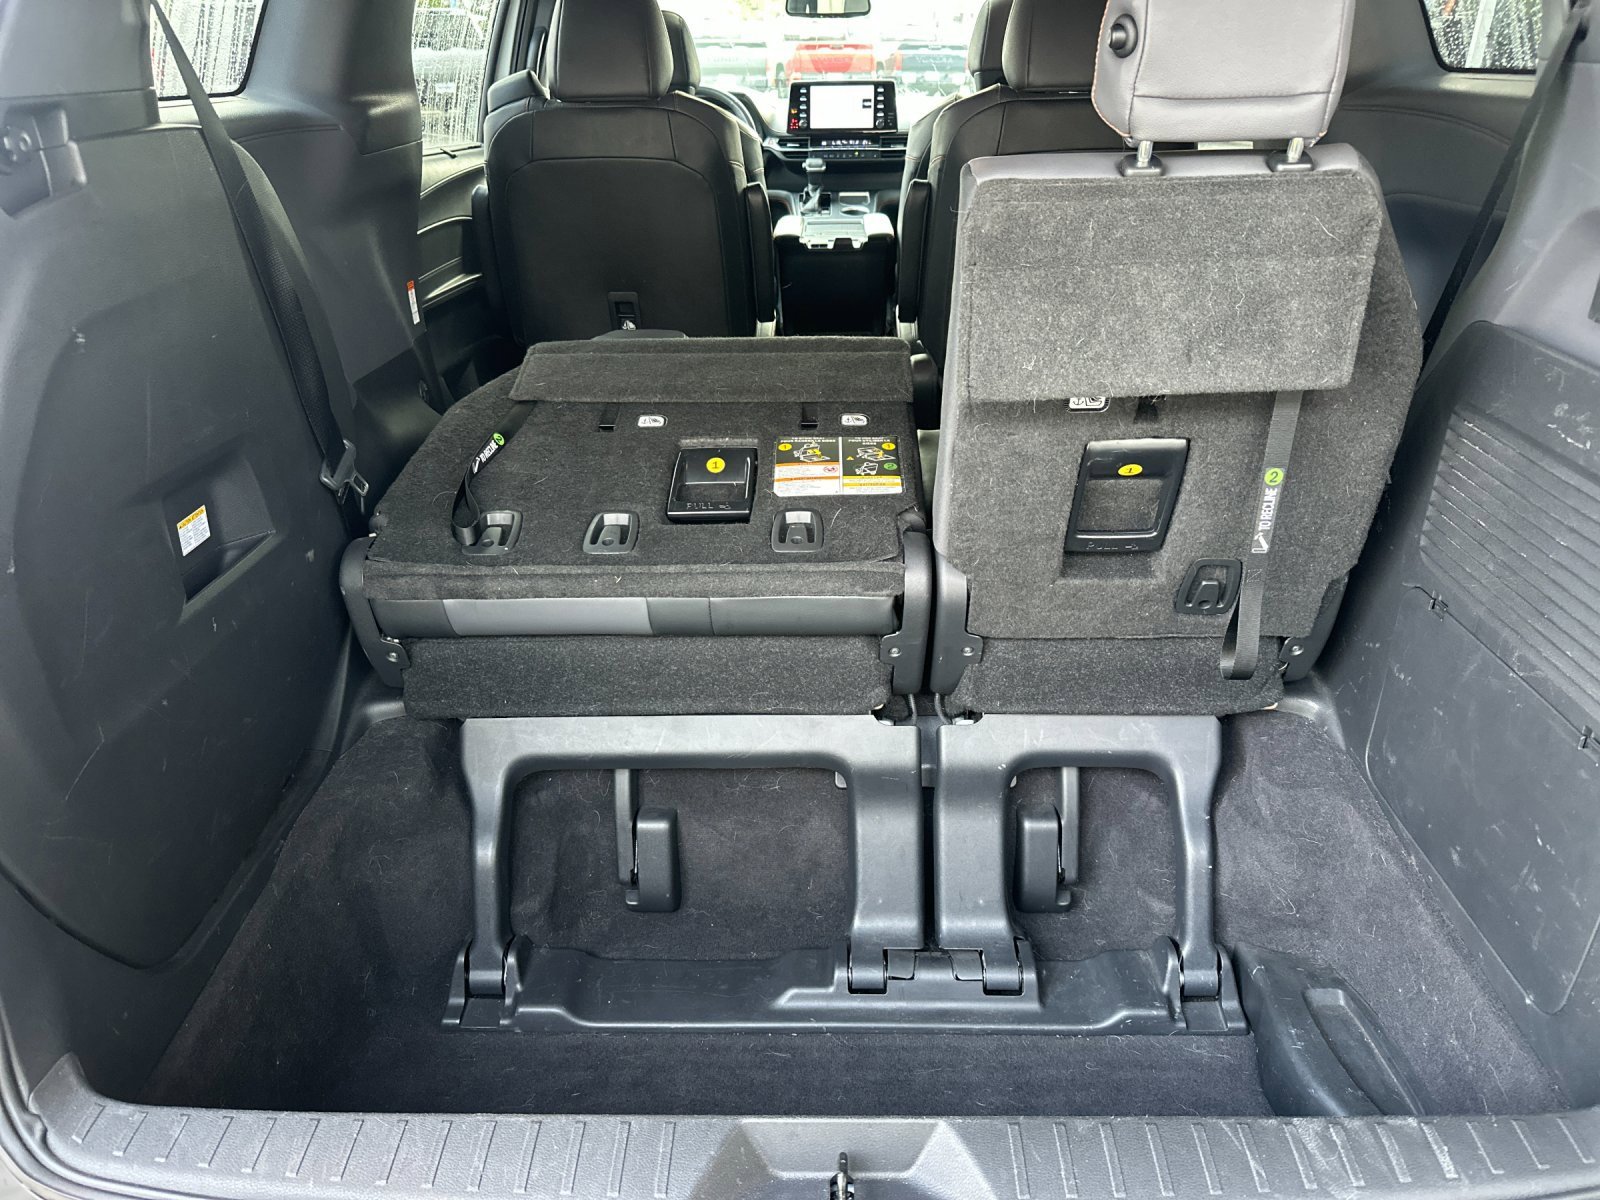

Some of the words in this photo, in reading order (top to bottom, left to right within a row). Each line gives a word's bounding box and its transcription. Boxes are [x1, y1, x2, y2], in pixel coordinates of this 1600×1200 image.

[1269, 471, 1279, 483] 2
[1260, 487, 1278, 520] RECLINE
[1258, 520, 1272, 531] TO
